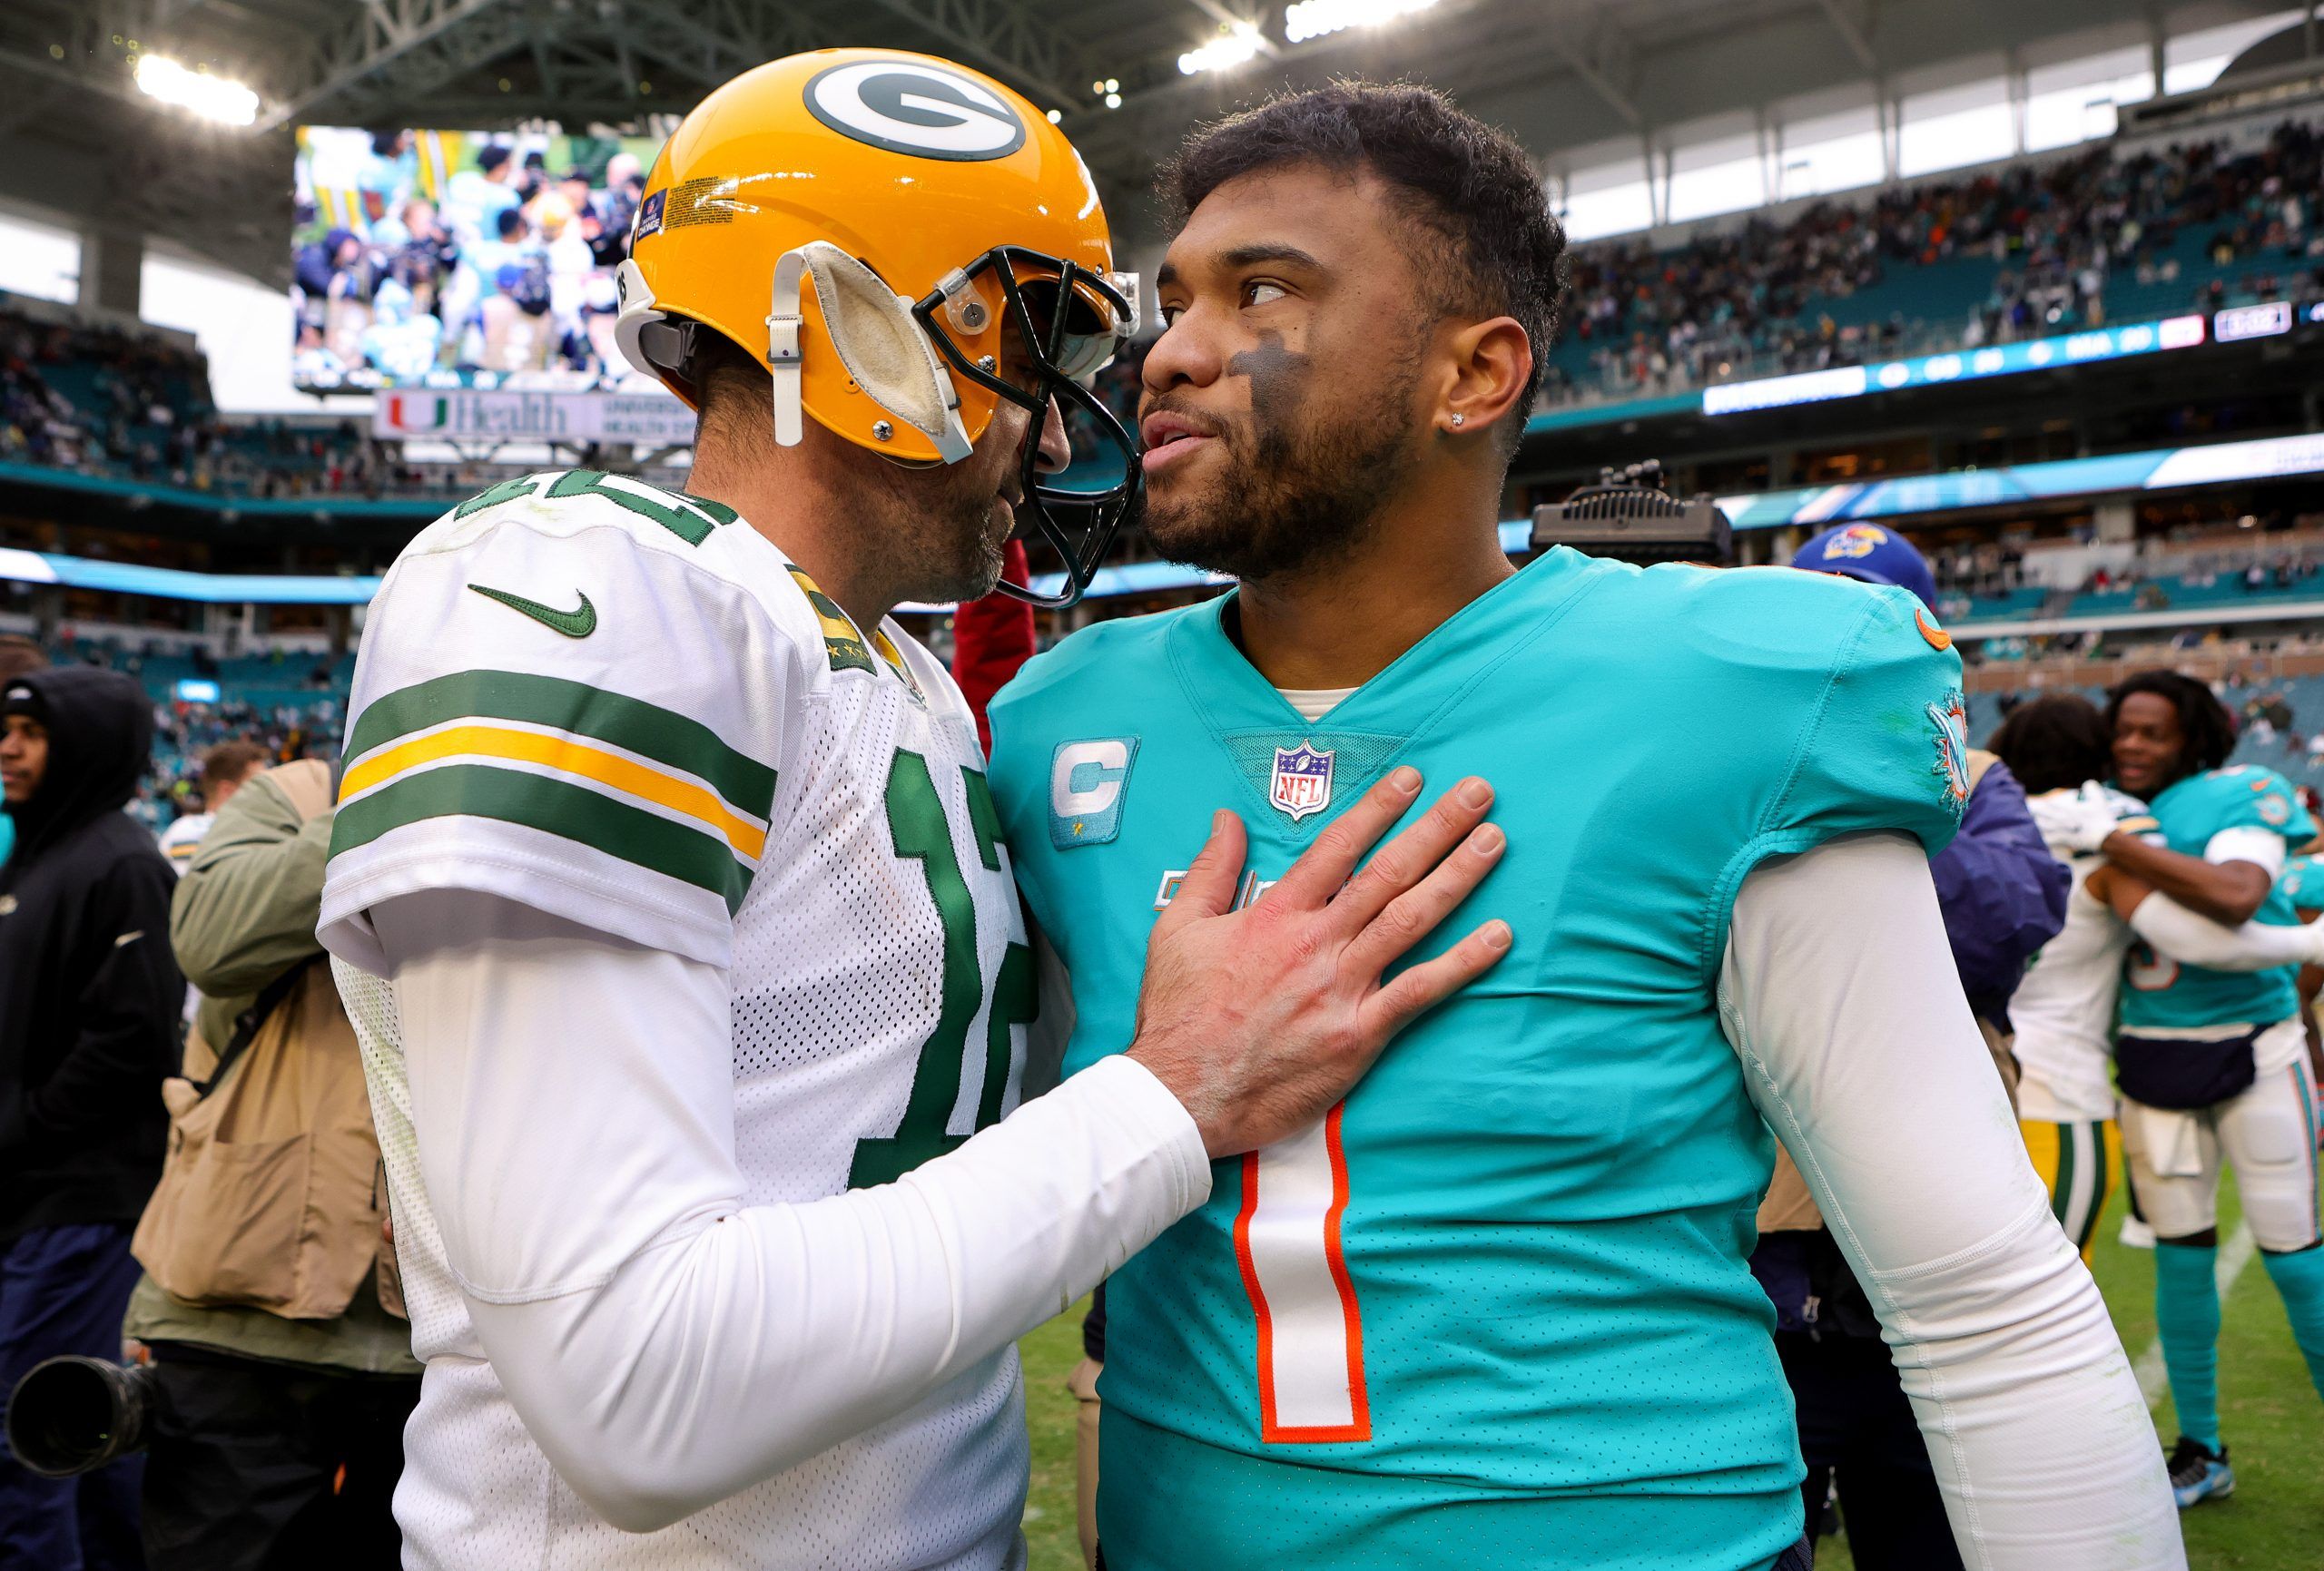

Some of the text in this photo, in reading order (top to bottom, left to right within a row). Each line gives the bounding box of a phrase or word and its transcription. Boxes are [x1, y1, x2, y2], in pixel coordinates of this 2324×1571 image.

[813, 63, 1017, 152] G
[1051, 741, 1128, 818] C
[1277, 774, 1321, 807] NFL
